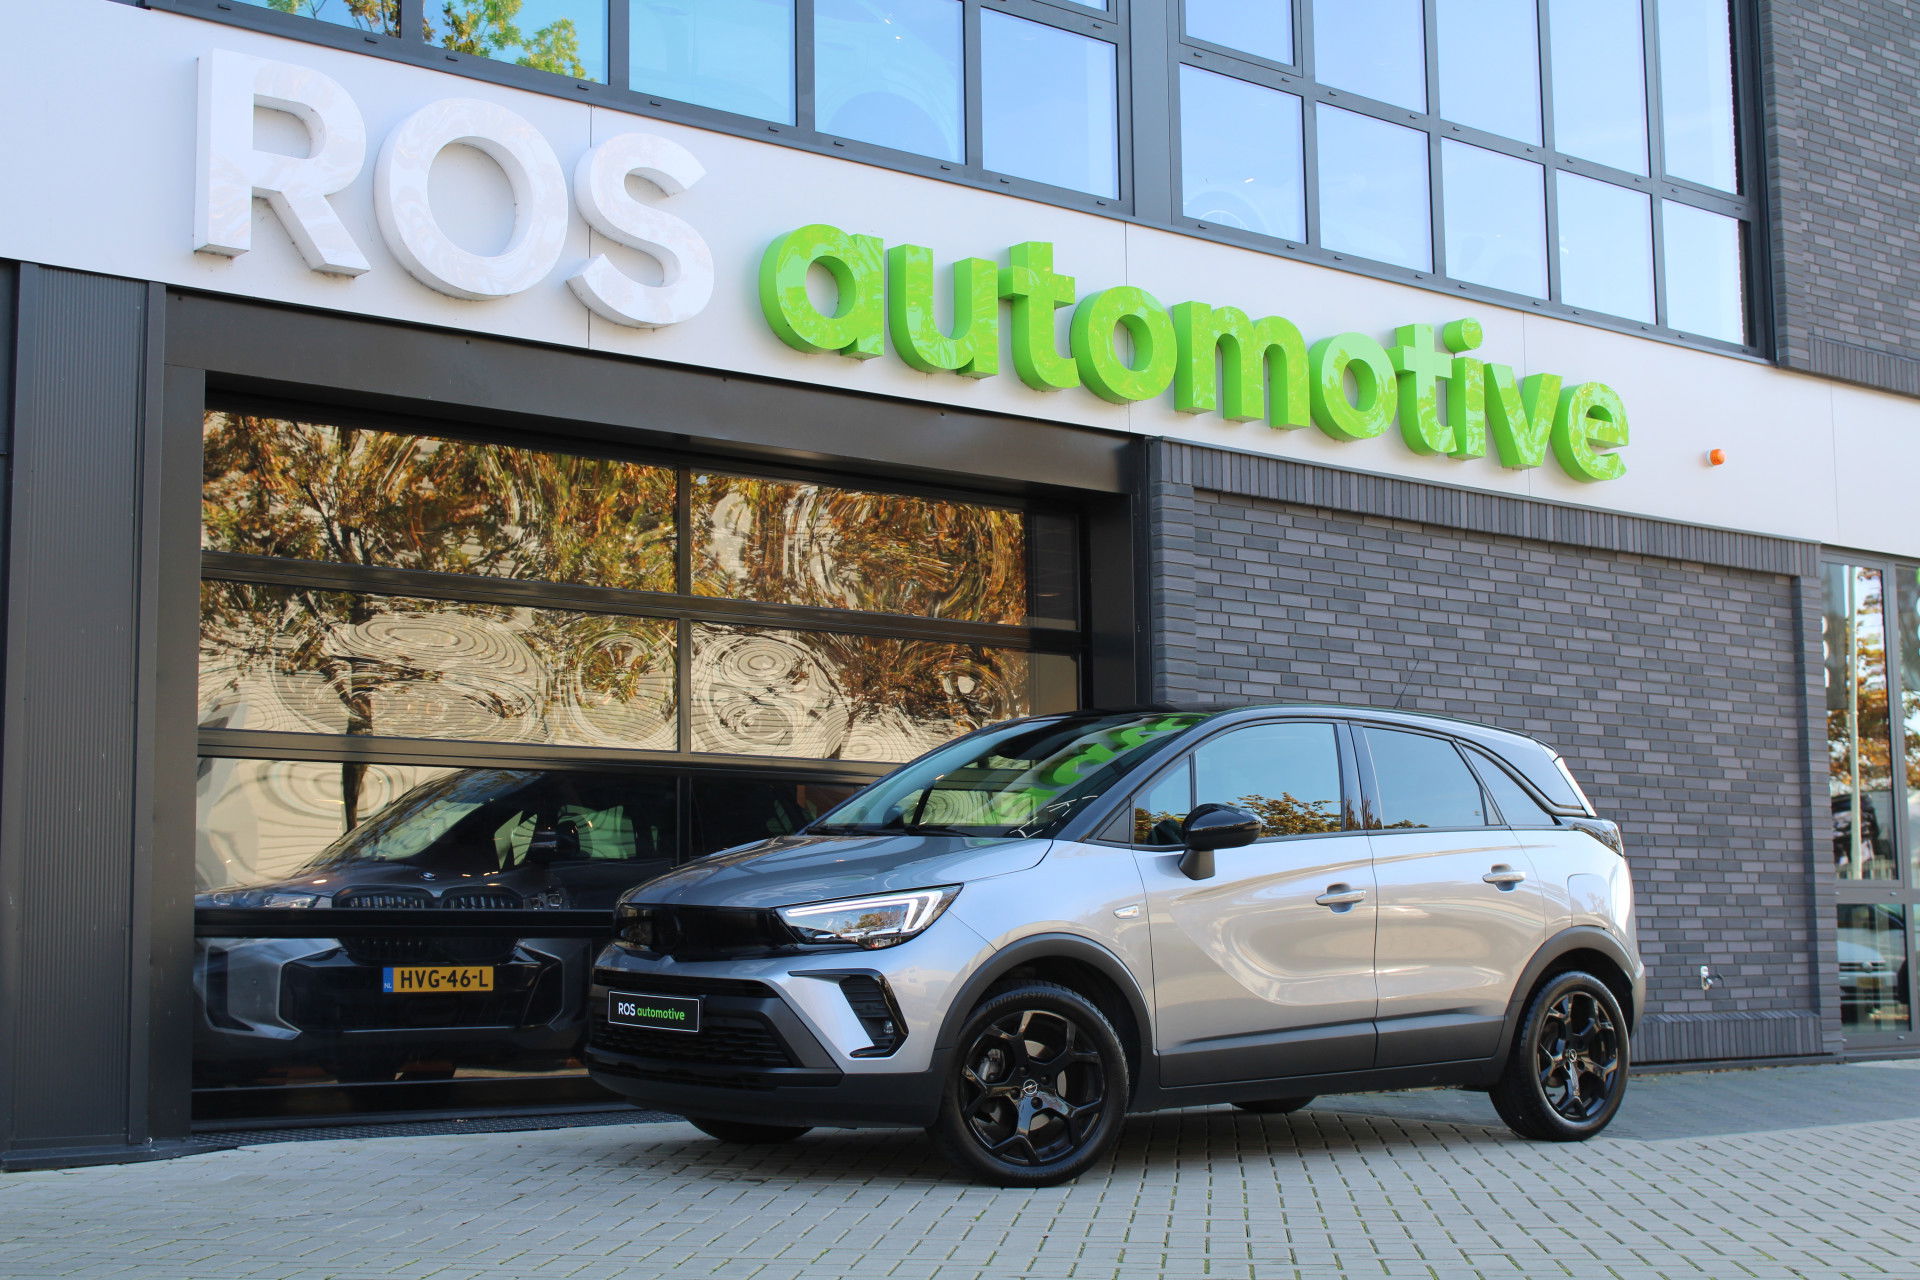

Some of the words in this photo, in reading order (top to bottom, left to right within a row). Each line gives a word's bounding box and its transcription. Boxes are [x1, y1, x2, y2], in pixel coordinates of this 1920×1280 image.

[193, 48, 715, 329] ROS
[758, 223, 1629, 483] automotive
[400, 969, 489, 989] HVG-46-L
[618, 1002, 636, 1016] ROS
[637, 1006, 686, 1020] automotive
